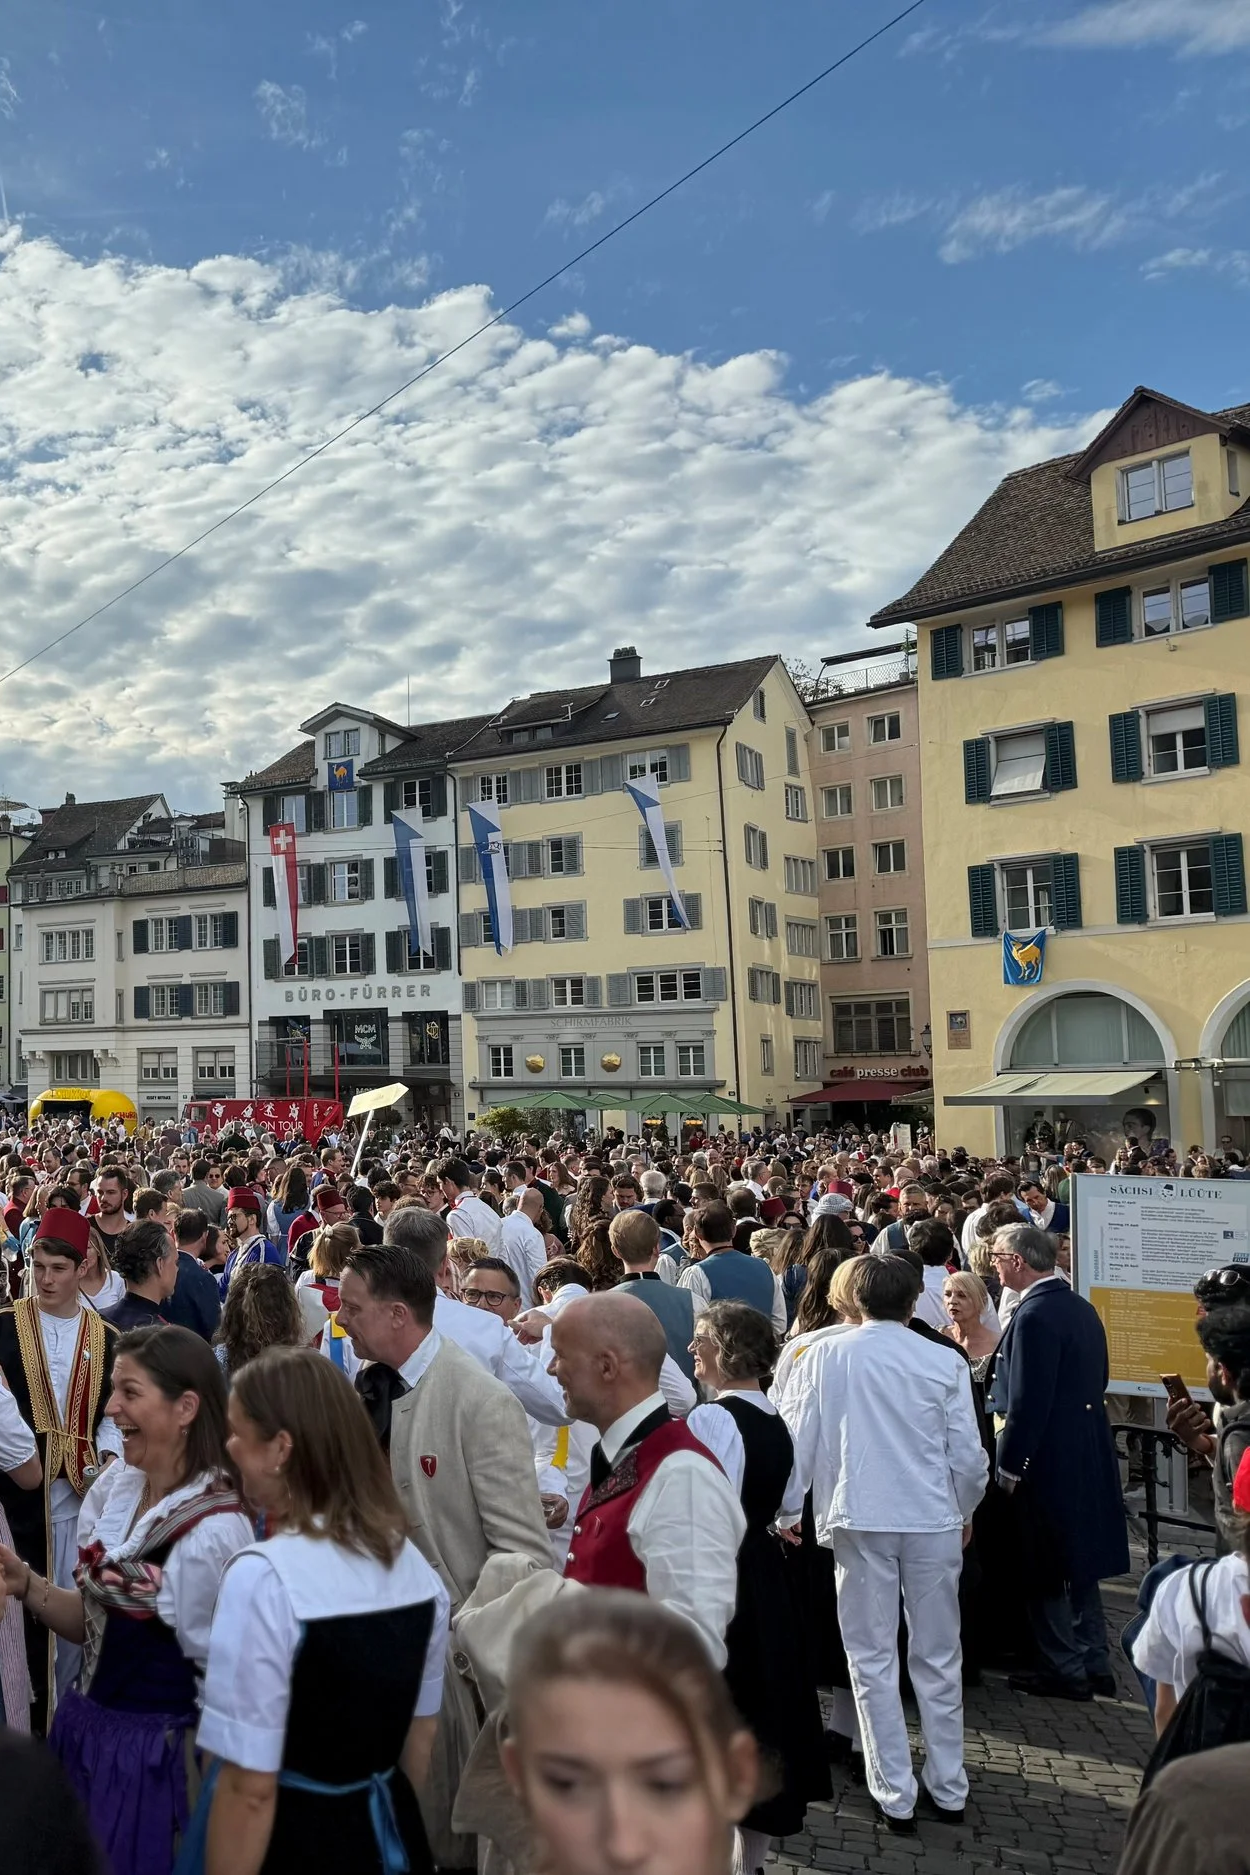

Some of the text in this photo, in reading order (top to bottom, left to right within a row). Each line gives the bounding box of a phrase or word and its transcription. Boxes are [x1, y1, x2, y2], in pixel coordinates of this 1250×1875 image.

[550, 1016, 632, 1028] SCHIRMFABRIK
[354, 1024, 376, 1033] MCM
[829, 1065, 929, 1080] café presse club
[260, 1121, 275, 1130] ON
[278, 1121, 304, 1131] TOUR
[1110, 1184, 1222, 1199] SÄCHSI LÜÜTE
